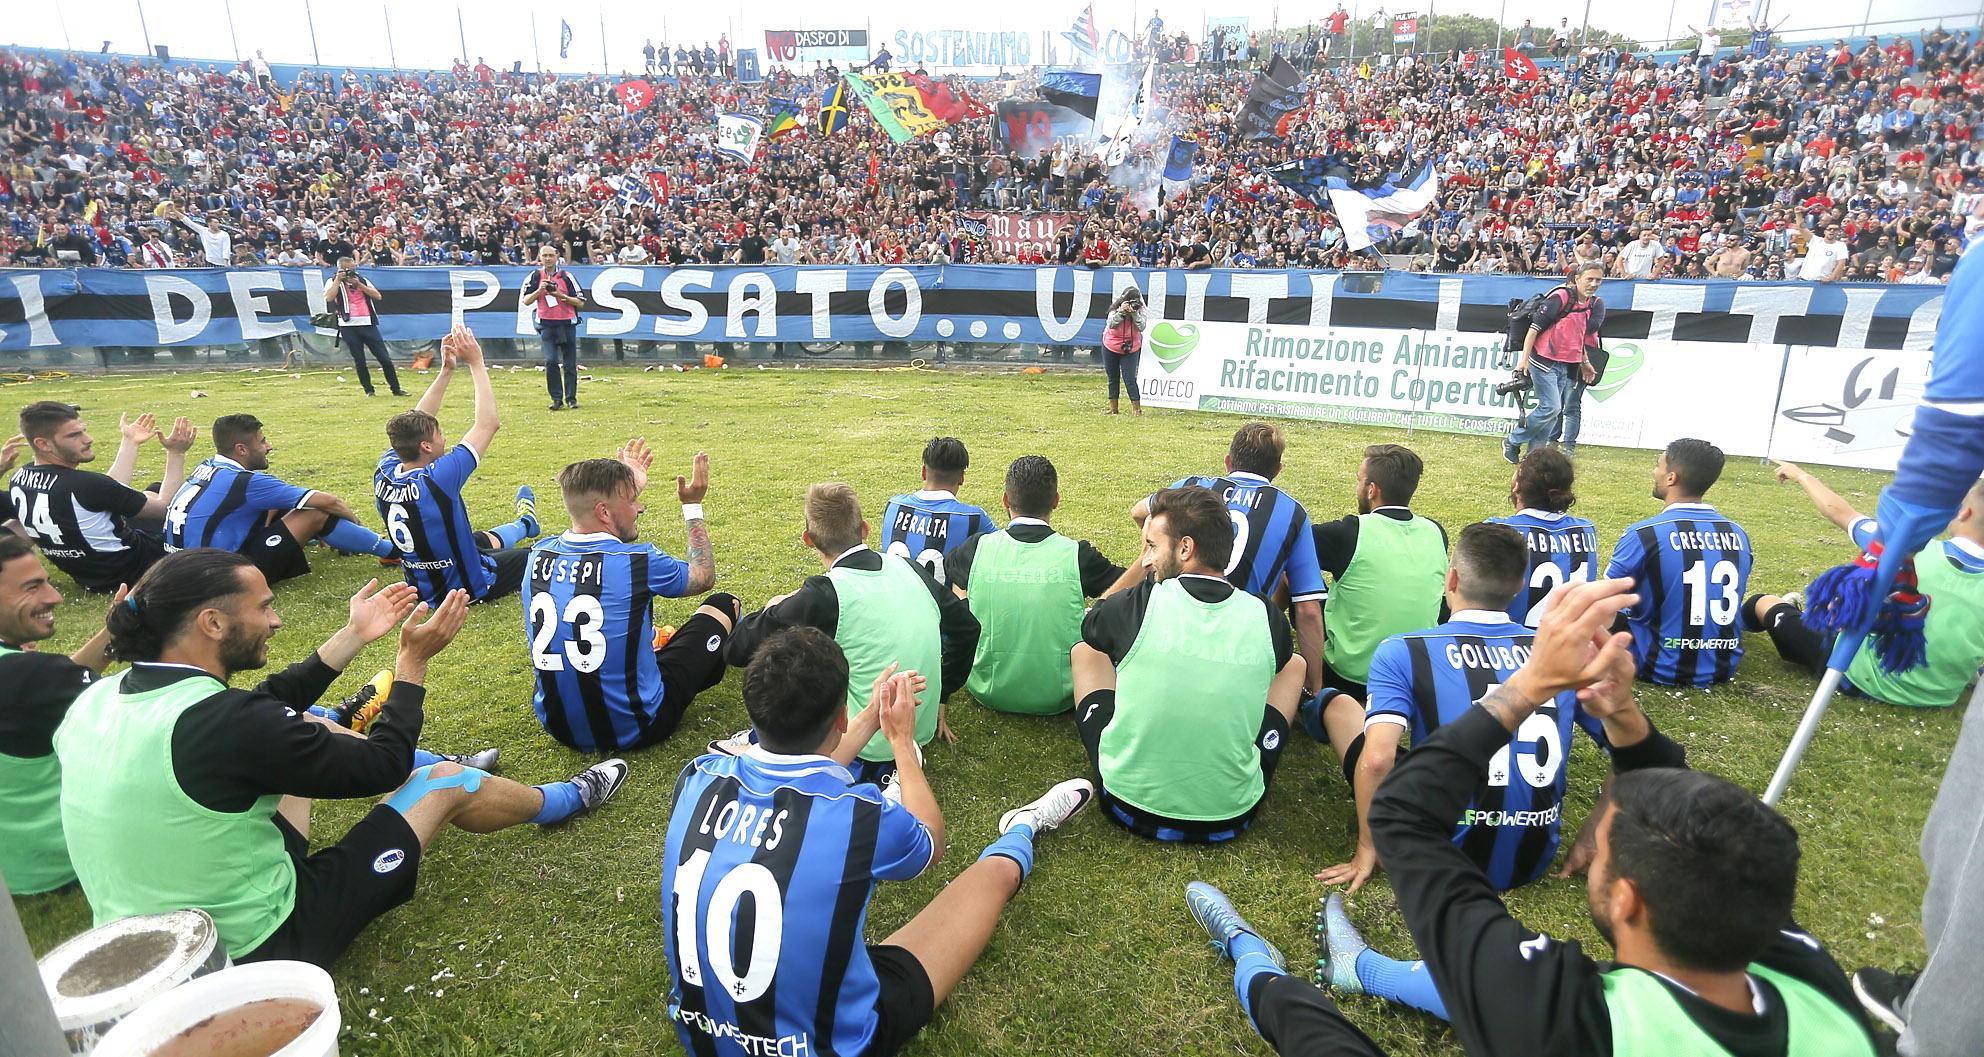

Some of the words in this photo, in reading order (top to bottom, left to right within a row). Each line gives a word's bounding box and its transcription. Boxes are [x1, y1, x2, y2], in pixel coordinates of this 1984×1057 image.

[795, 32, 835, 47] DASPO
[838, 31, 850, 46] DI
[895, 29, 1031, 66] SOSTENIAMO
[1245, 327, 1384, 363] Rimozione
[1393, 334, 1519, 371] Amianto
[1141, 378, 1194, 398] LOVECO
[1219, 358, 1380, 398] Rifacimento
[1217, 399, 1257, 412] LOTTIAMO
[1259, 402, 1275, 414] PER
[1276, 403, 1327, 418] RISTABILIRE
[1329, 407, 1341, 419] UN
[1343, 408, 1393, 423] EQUILIBRIO
[10, 486, 64, 545] 24
[387, 503, 415, 553] 6
[894, 511, 948, 539] PERALTA
[1518, 531, 1597, 554] ABANELLI
[1669, 530, 1744, 551] CRESCENZI
[531, 556, 603, 586] EUSEPI
[1682, 560, 1740, 626] 13
[529, 591, 607, 674] 23
[699, 794, 789, 851] LORES
[672, 847, 783, 1003] 10
